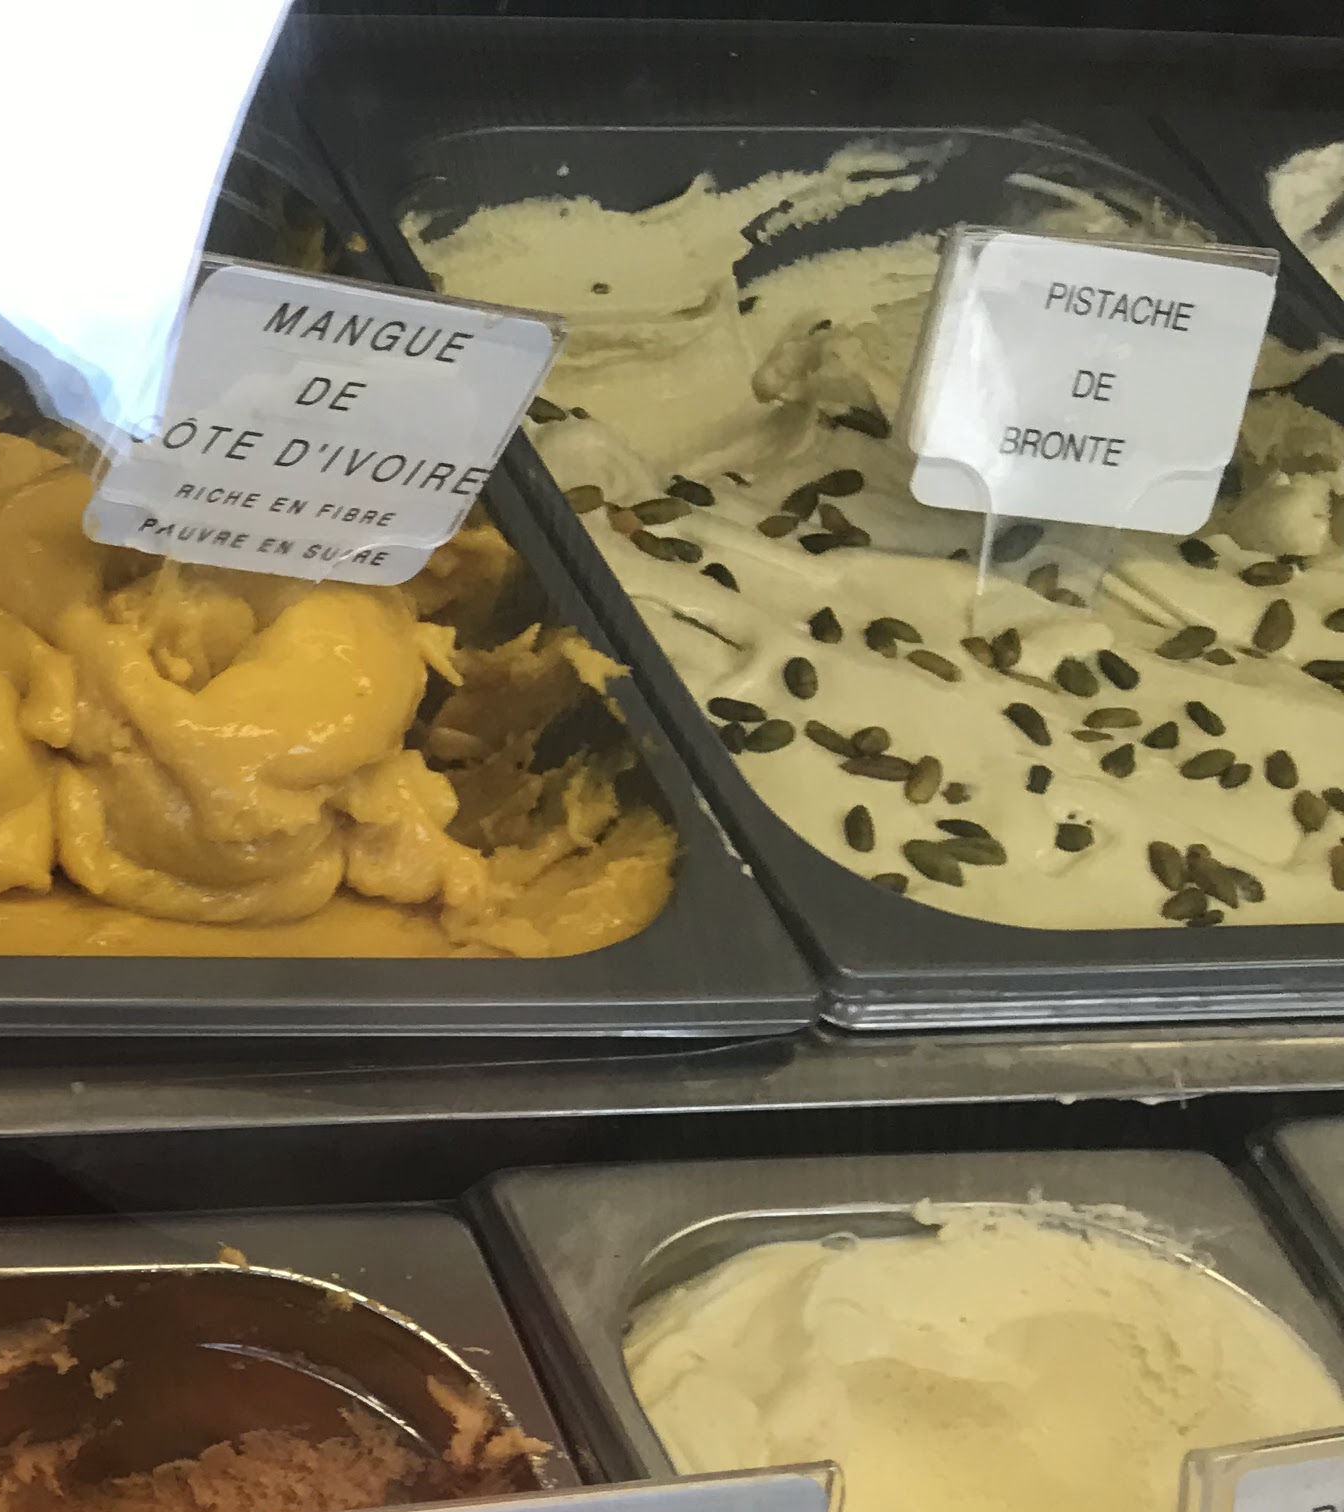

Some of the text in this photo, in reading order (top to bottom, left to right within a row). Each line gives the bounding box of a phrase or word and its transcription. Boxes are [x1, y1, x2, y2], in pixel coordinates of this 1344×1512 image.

[1044, 282, 1196, 332] PISTACHE
[262, 302, 474, 364] MANGUE
[295, 376, 367, 412] DE
[1071, 369, 1117, 402] DE
[273, 437, 491, 498] D'IVOIRE
[998, 426, 1126, 467] BRONTE
[175, 483, 397, 528] RICHE EN FIBRE
[137, 517, 249, 550] PAUVRE
[256, 537, 294, 555] EN
